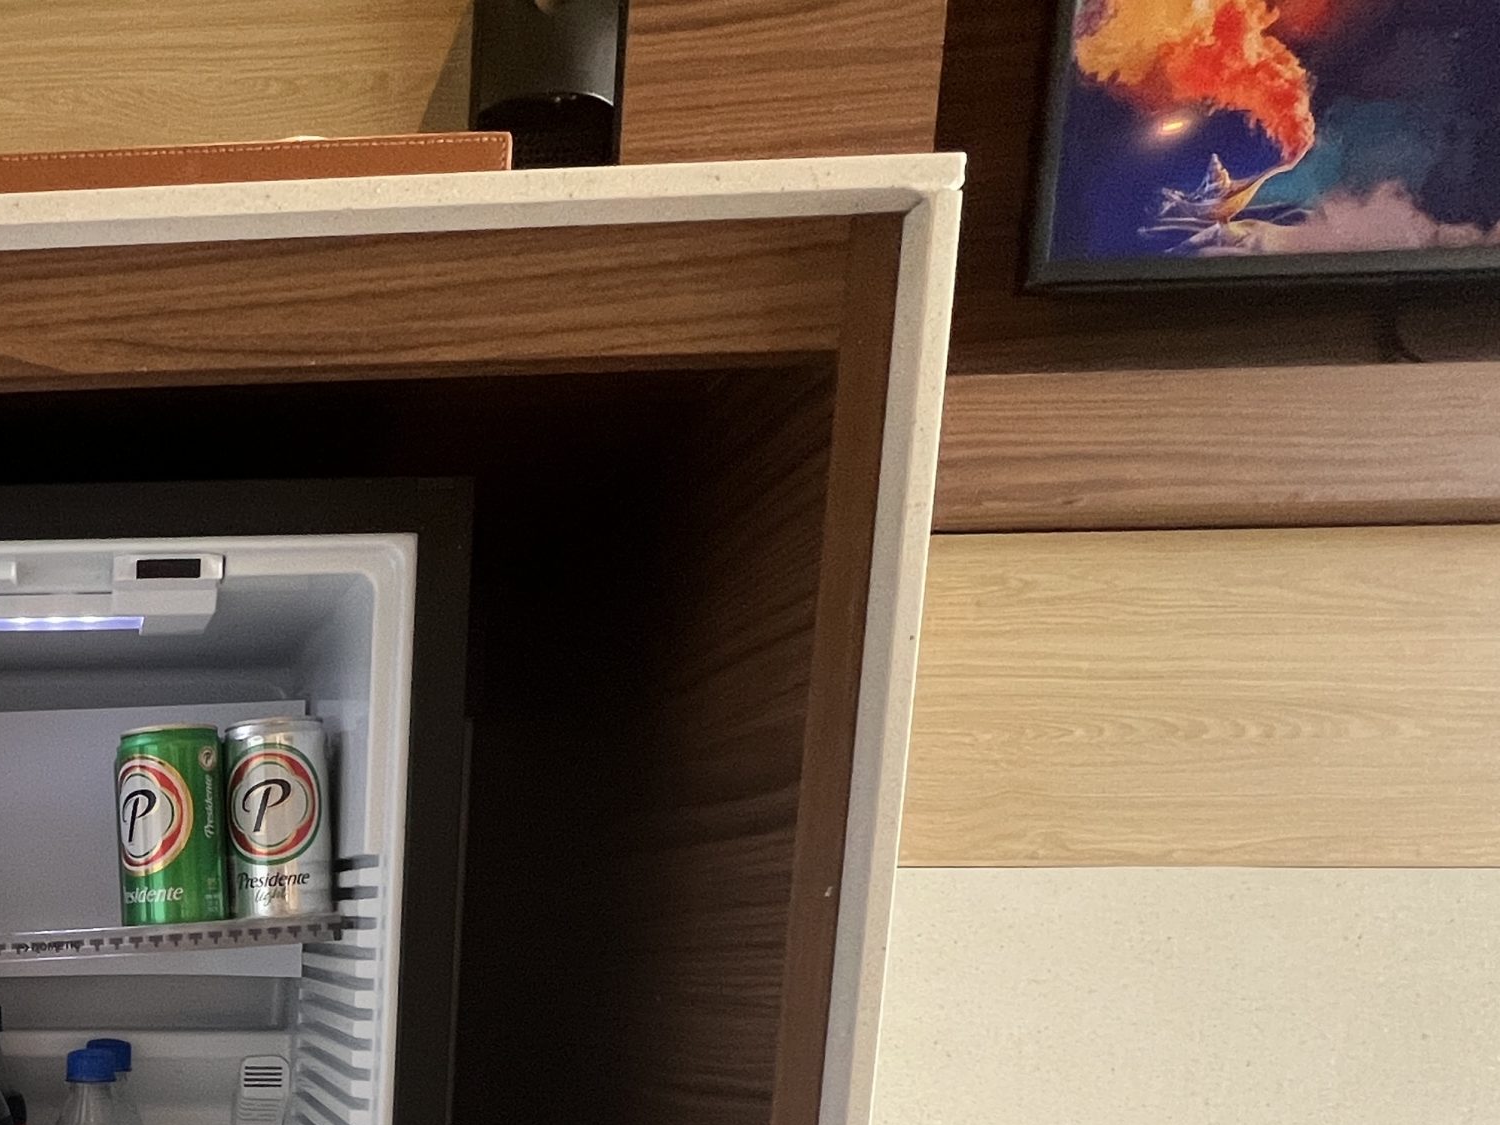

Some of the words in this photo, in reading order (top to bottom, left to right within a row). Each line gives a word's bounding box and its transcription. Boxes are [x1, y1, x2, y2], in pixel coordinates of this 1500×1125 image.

[122, 789, 157, 843] P
[204, 774, 214, 839] Presidente
[241, 778, 292, 833] P
[237, 872, 310, 890] Presidente
